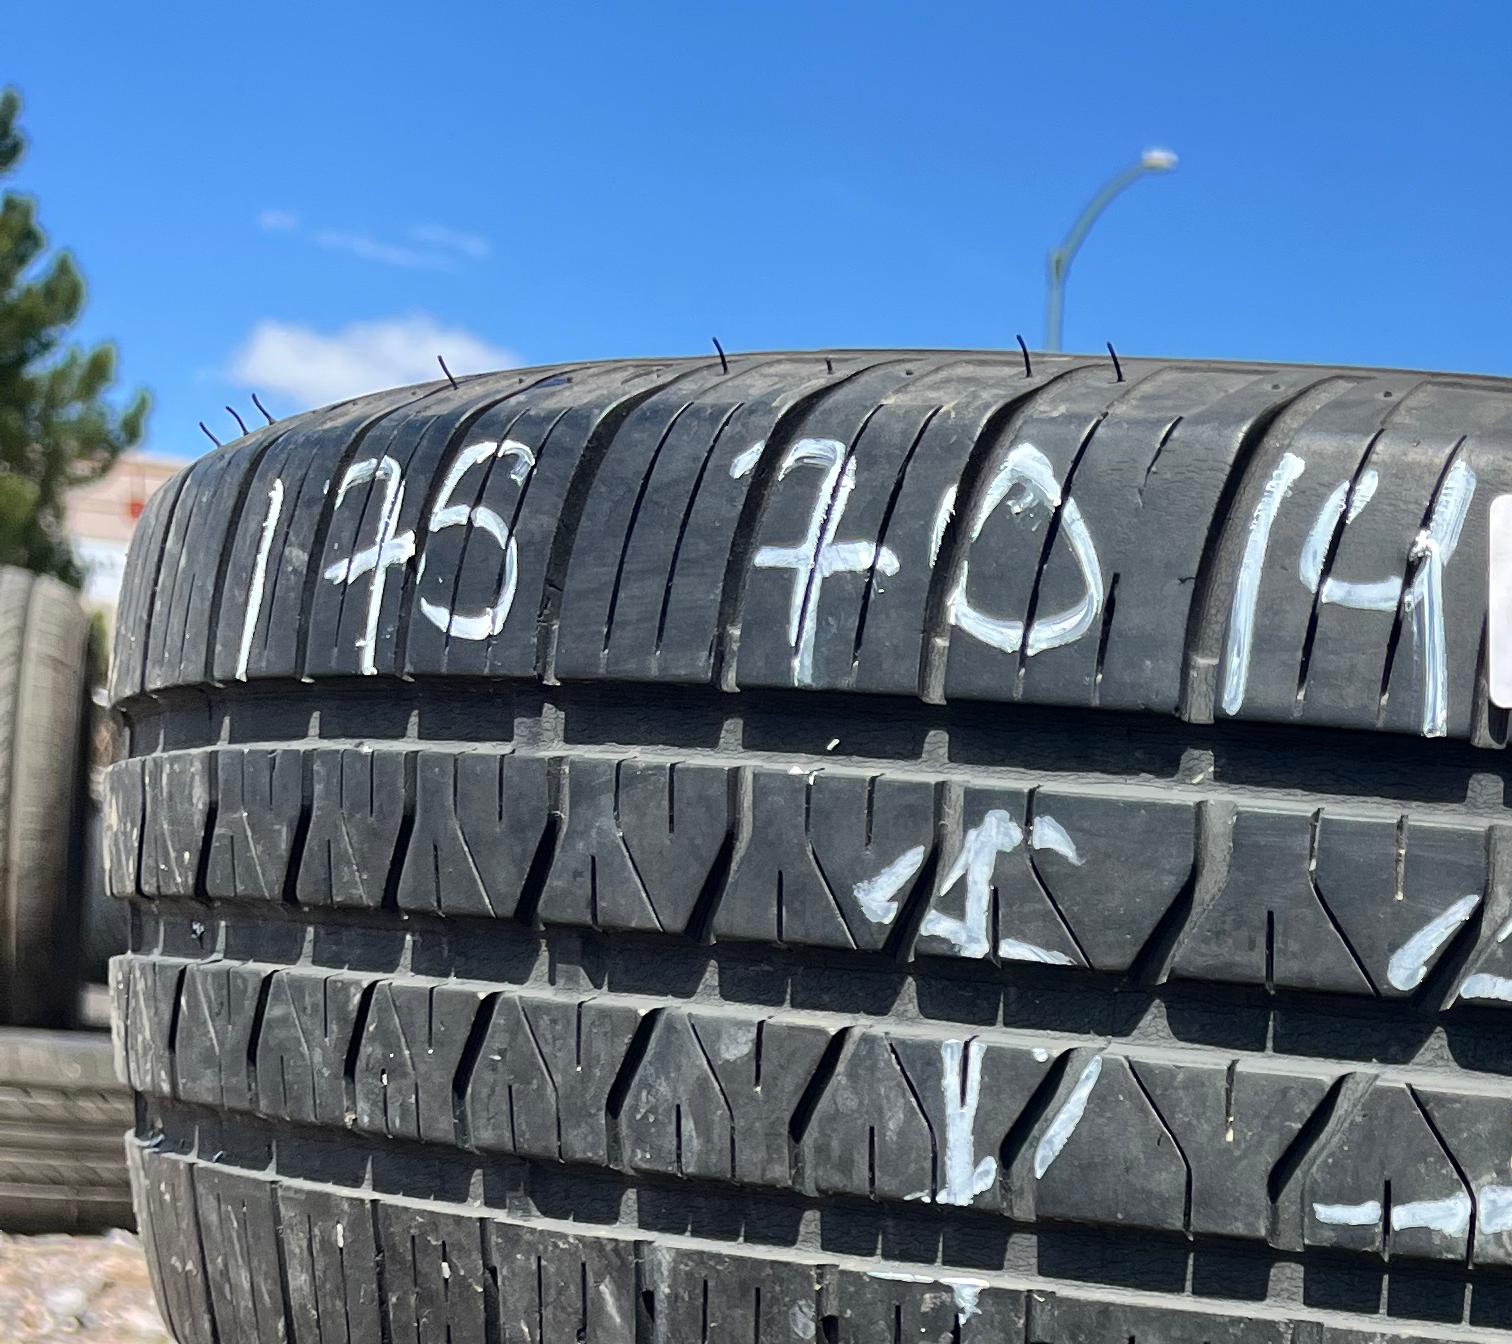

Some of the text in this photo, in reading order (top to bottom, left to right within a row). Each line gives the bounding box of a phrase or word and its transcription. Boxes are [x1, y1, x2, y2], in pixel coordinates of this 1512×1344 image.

[235, 437, 1477, 738] 175 70 14
